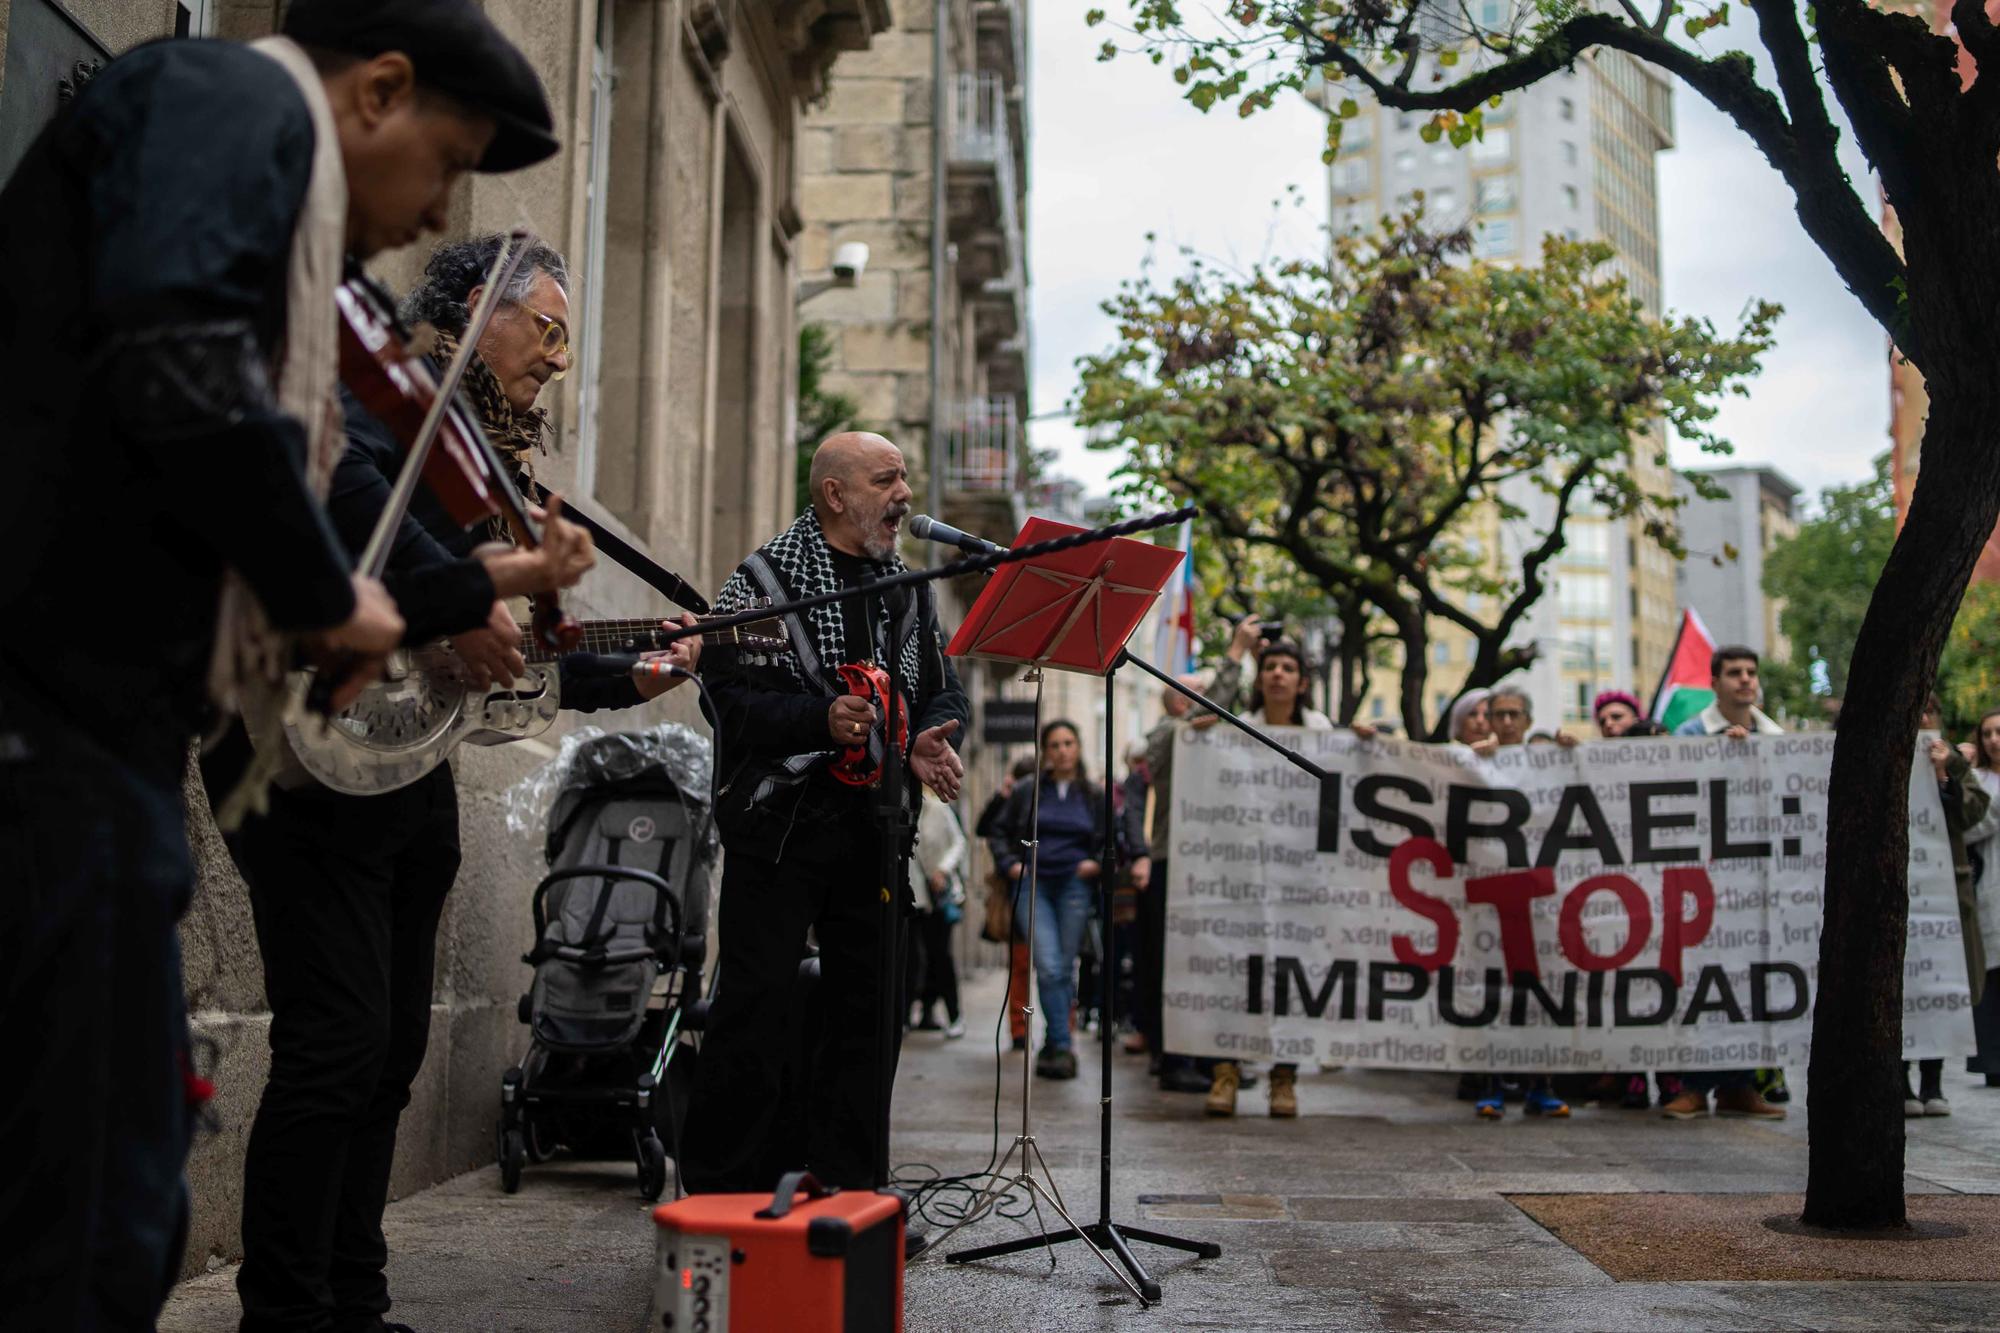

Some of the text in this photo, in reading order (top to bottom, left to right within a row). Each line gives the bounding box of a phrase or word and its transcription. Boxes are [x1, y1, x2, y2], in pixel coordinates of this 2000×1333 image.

[1218, 764, 1319, 791] aparthe
[1589, 743, 1670, 766] ameaza
[1679, 738, 1768, 763] nuclear,
[1180, 800, 1264, 827] limpeza
[1316, 771, 1802, 867] ISRAEL:
[1389, 836, 1716, 988] STOP
[1246, 953, 1810, 1029] IMPUNIDAD
